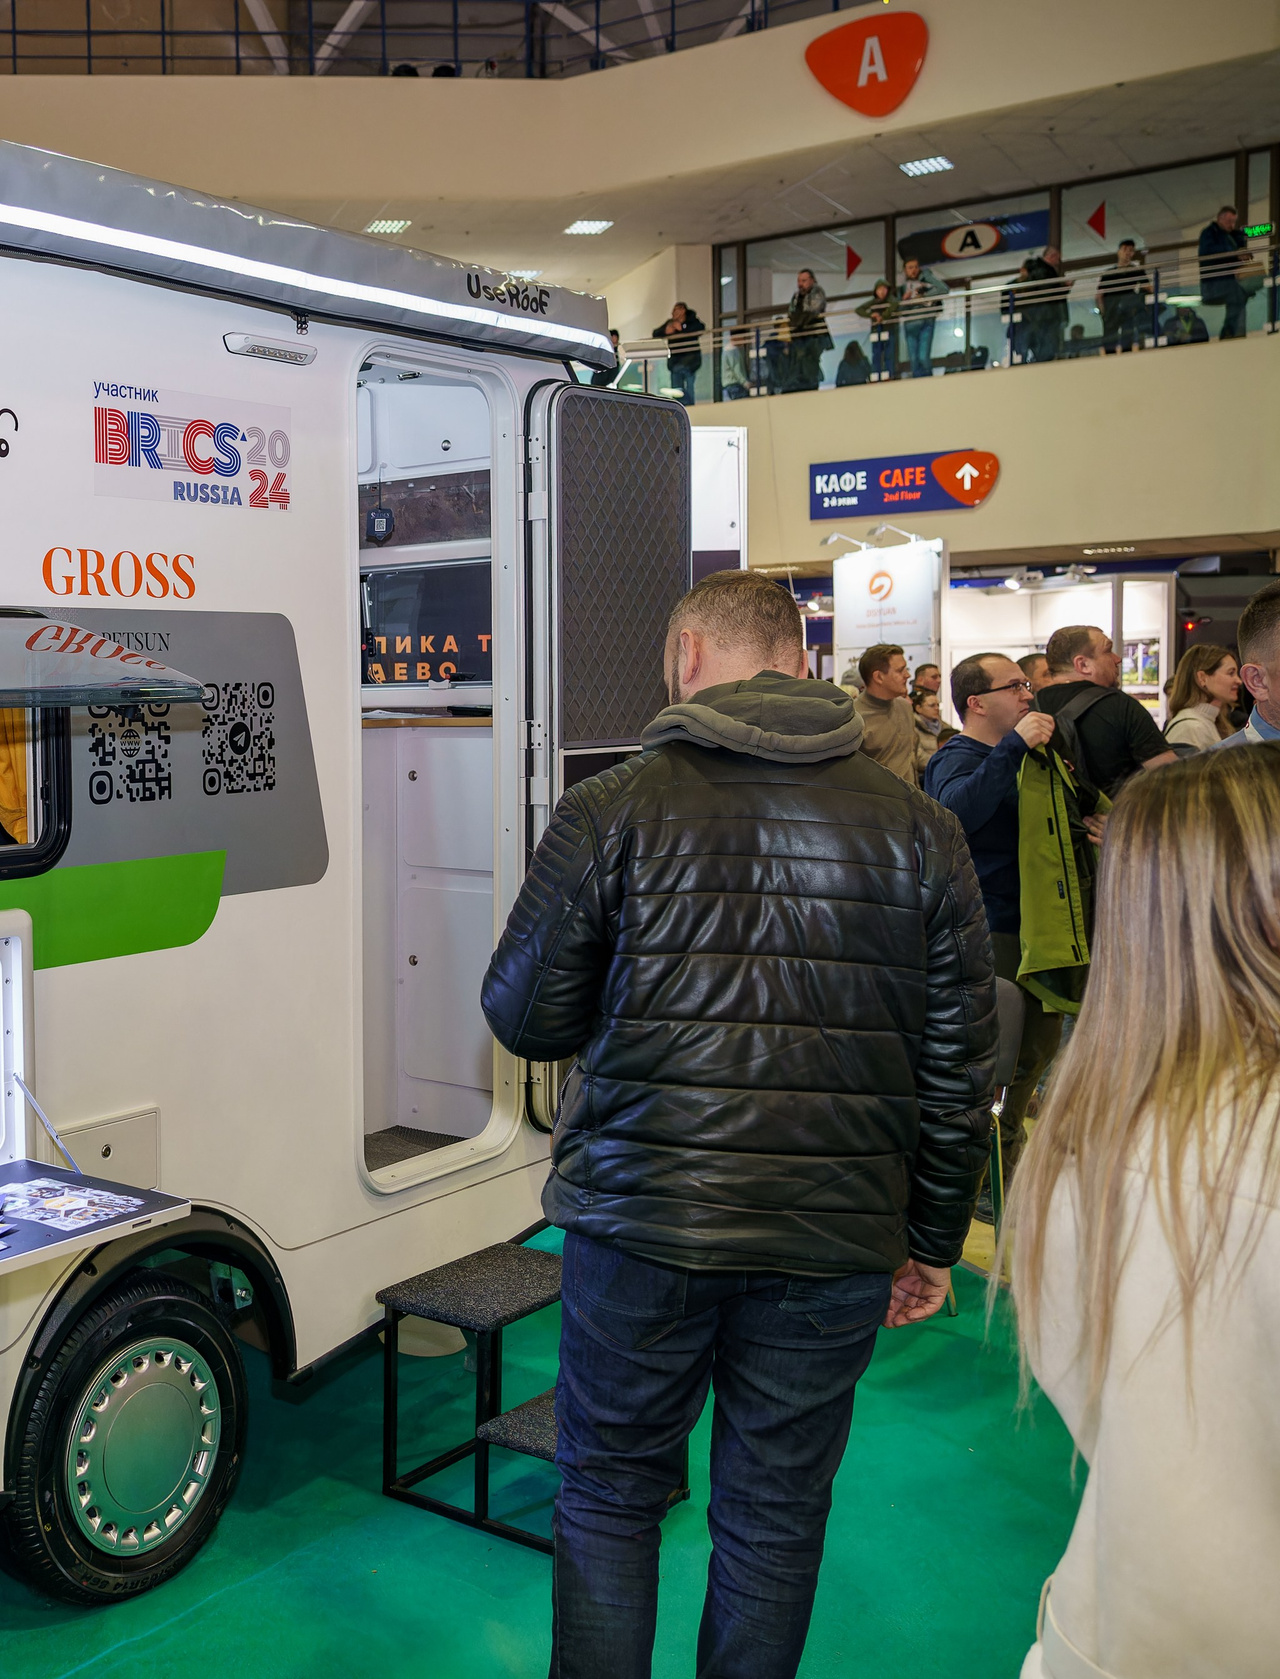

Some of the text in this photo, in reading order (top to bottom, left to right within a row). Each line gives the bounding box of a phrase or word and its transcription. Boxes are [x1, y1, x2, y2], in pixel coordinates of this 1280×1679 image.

[857, 35, 888, 88] A
[93, 381, 159, 402] участник
[94, 406, 291, 478] BRICS 20
[173, 469, 290, 511] RUSSIA 24
[815, 471, 867, 494] КАФЕ
[879, 466, 926, 489] CAFE
[42, 546, 196, 599] GROSS
